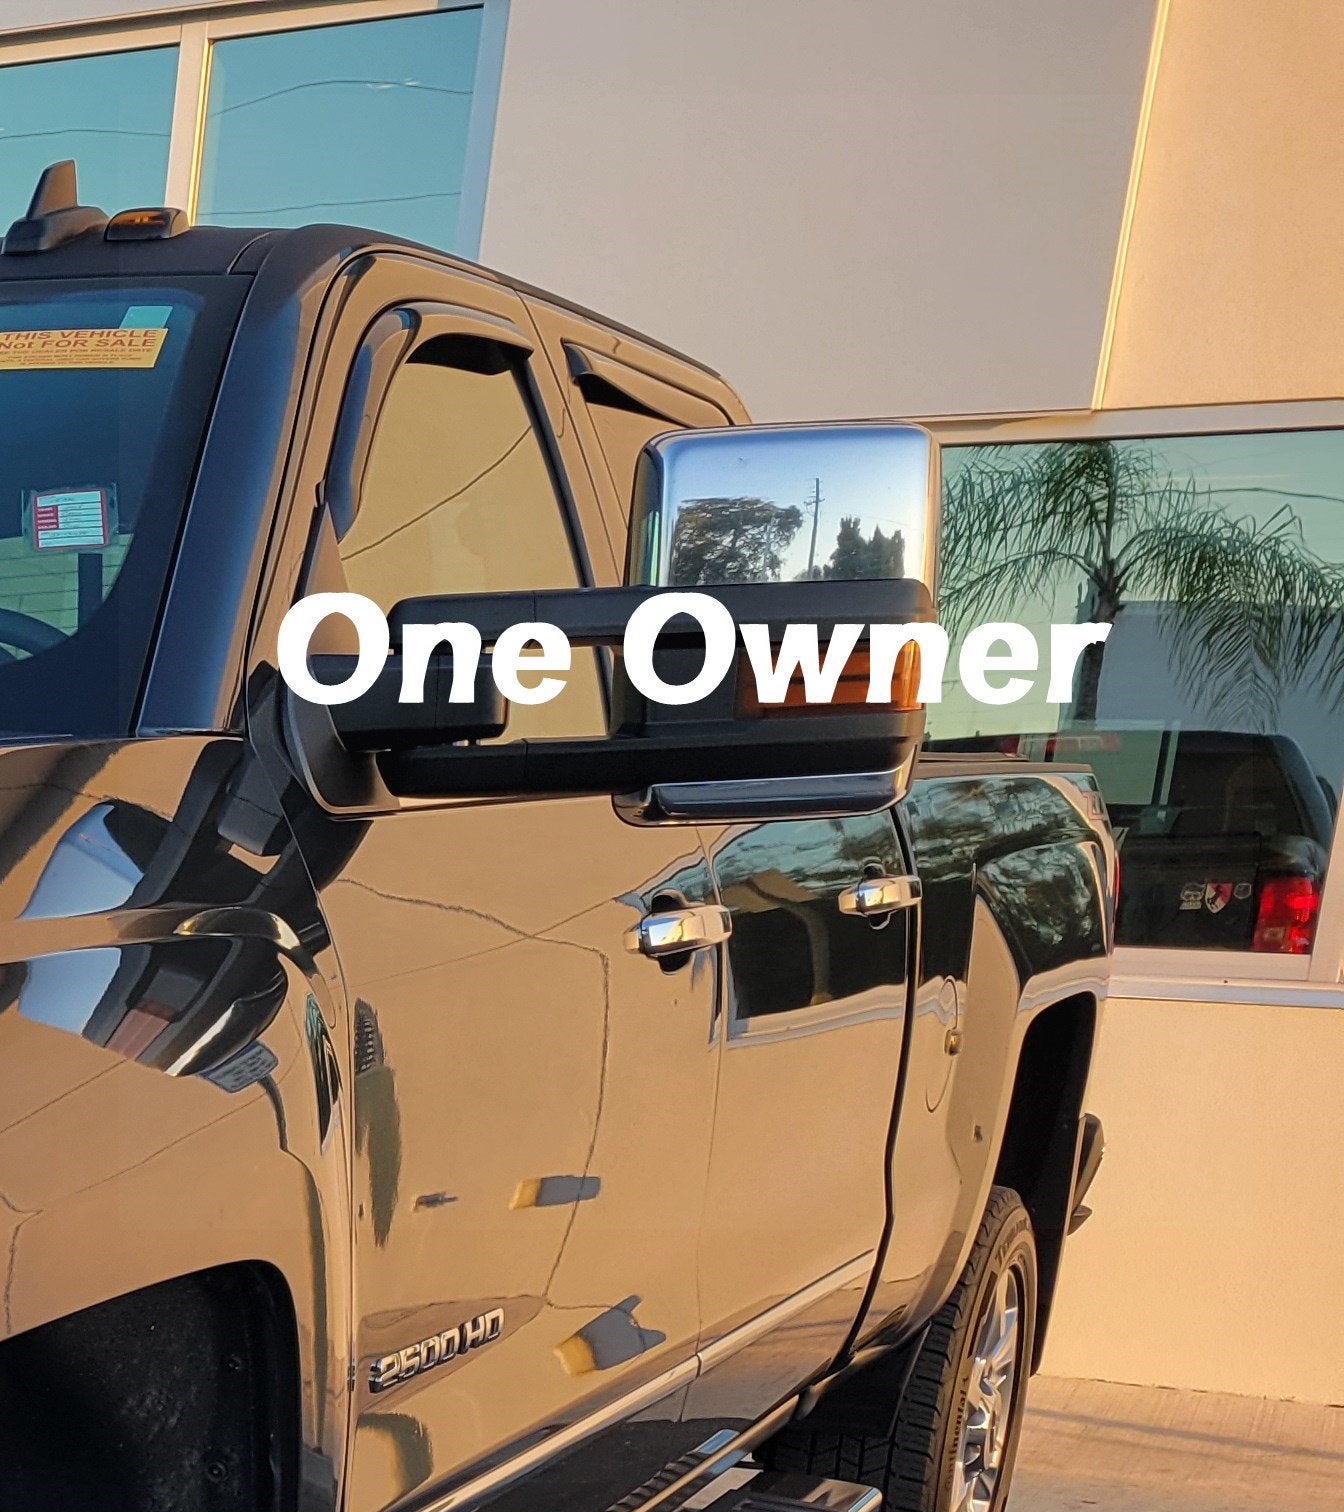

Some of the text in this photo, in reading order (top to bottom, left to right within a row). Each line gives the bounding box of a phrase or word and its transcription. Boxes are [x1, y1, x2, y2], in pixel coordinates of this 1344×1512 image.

[2, 329, 158, 341] THIS VEHICLE
[40, 339, 87, 349] FOR
[94, 338, 157, 348] SALE
